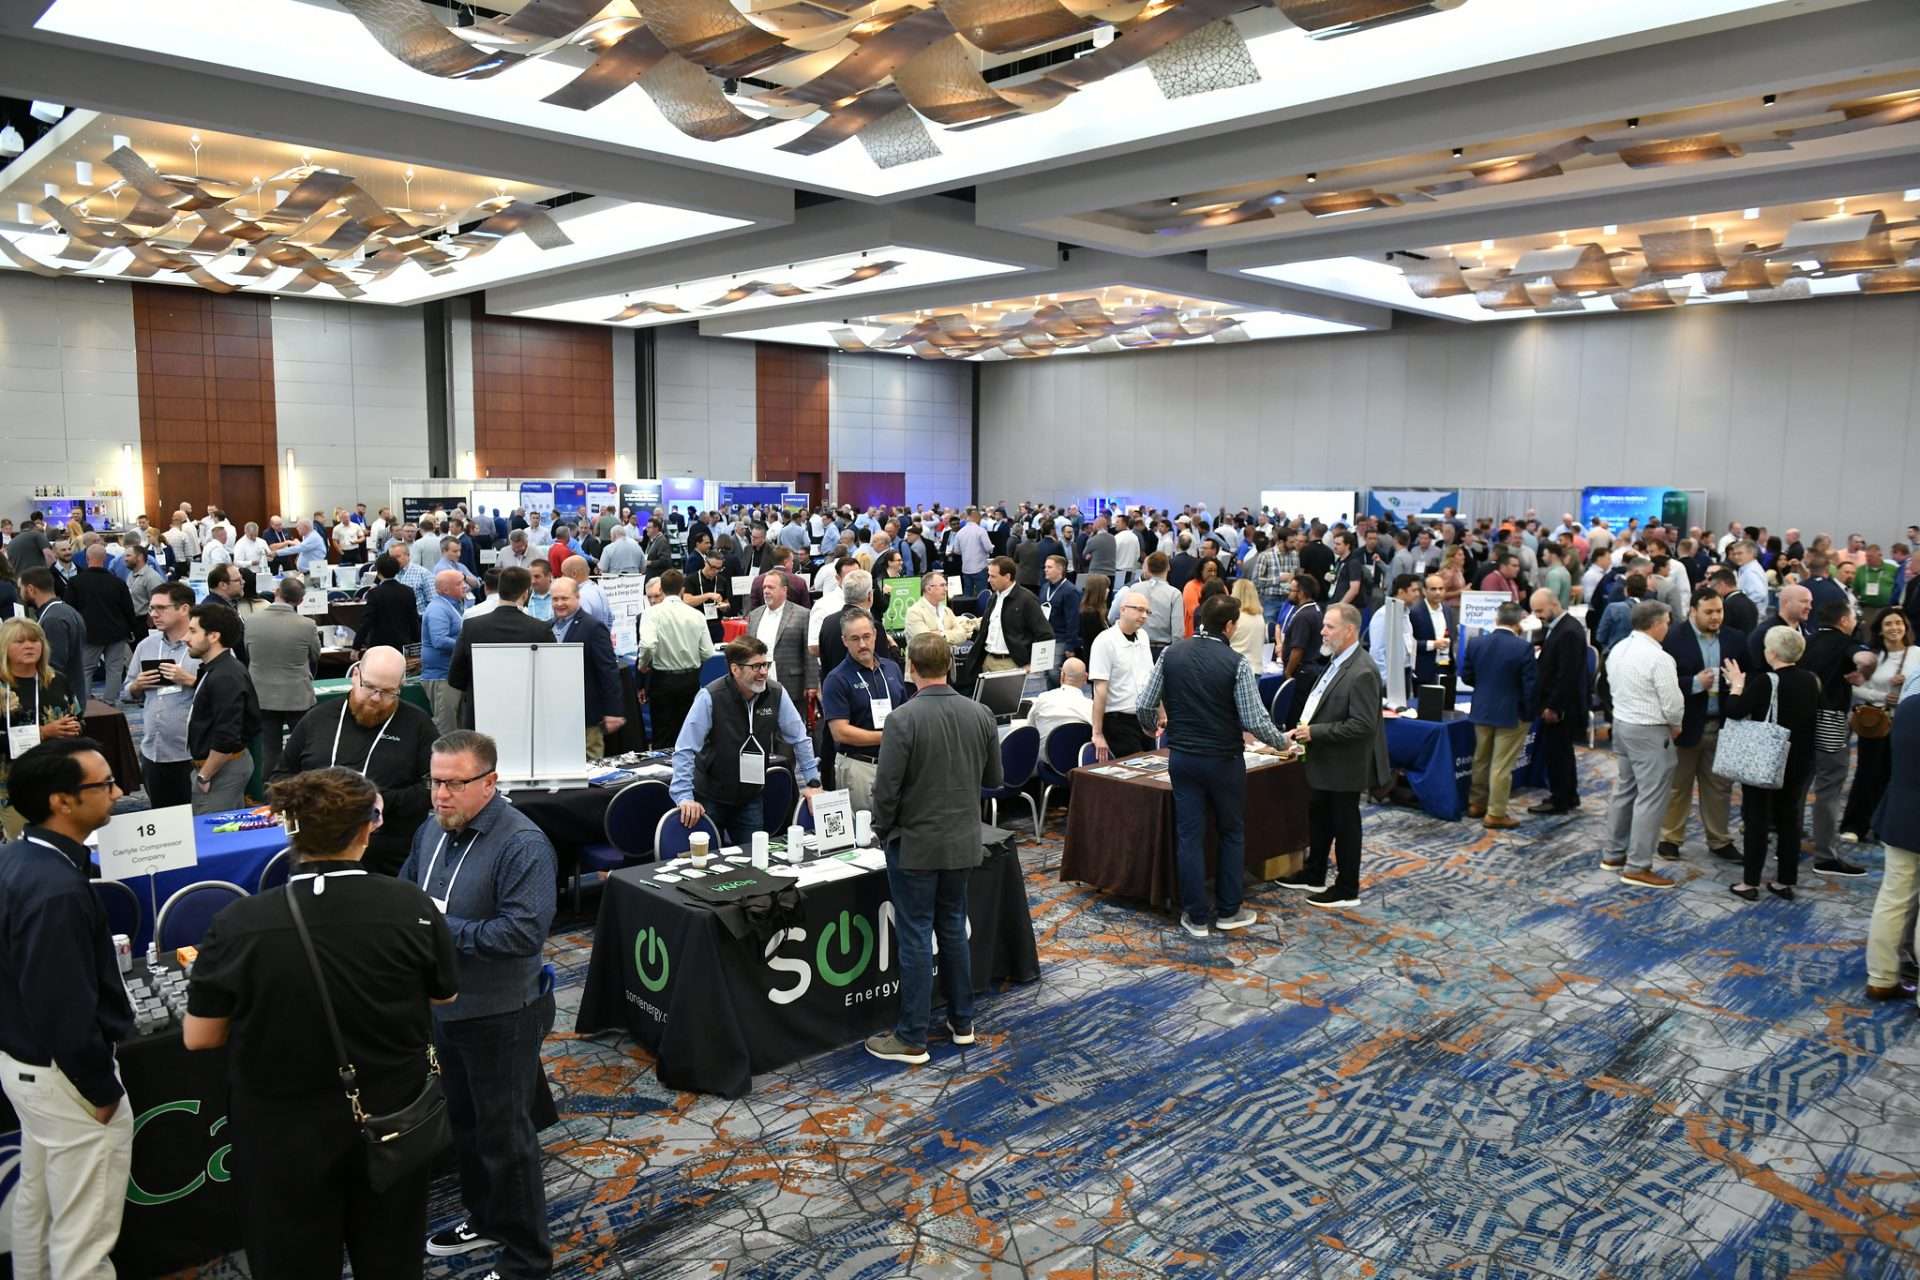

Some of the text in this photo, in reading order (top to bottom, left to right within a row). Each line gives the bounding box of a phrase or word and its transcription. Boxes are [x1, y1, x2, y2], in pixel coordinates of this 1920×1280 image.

[1465, 603, 1498, 611] Preserv
[137, 824, 156, 837] 18
[112, 840, 182, 857] Carlyle Compressor
[131, 853, 166, 864] Company
[844, 977, 901, 1007] Energy
